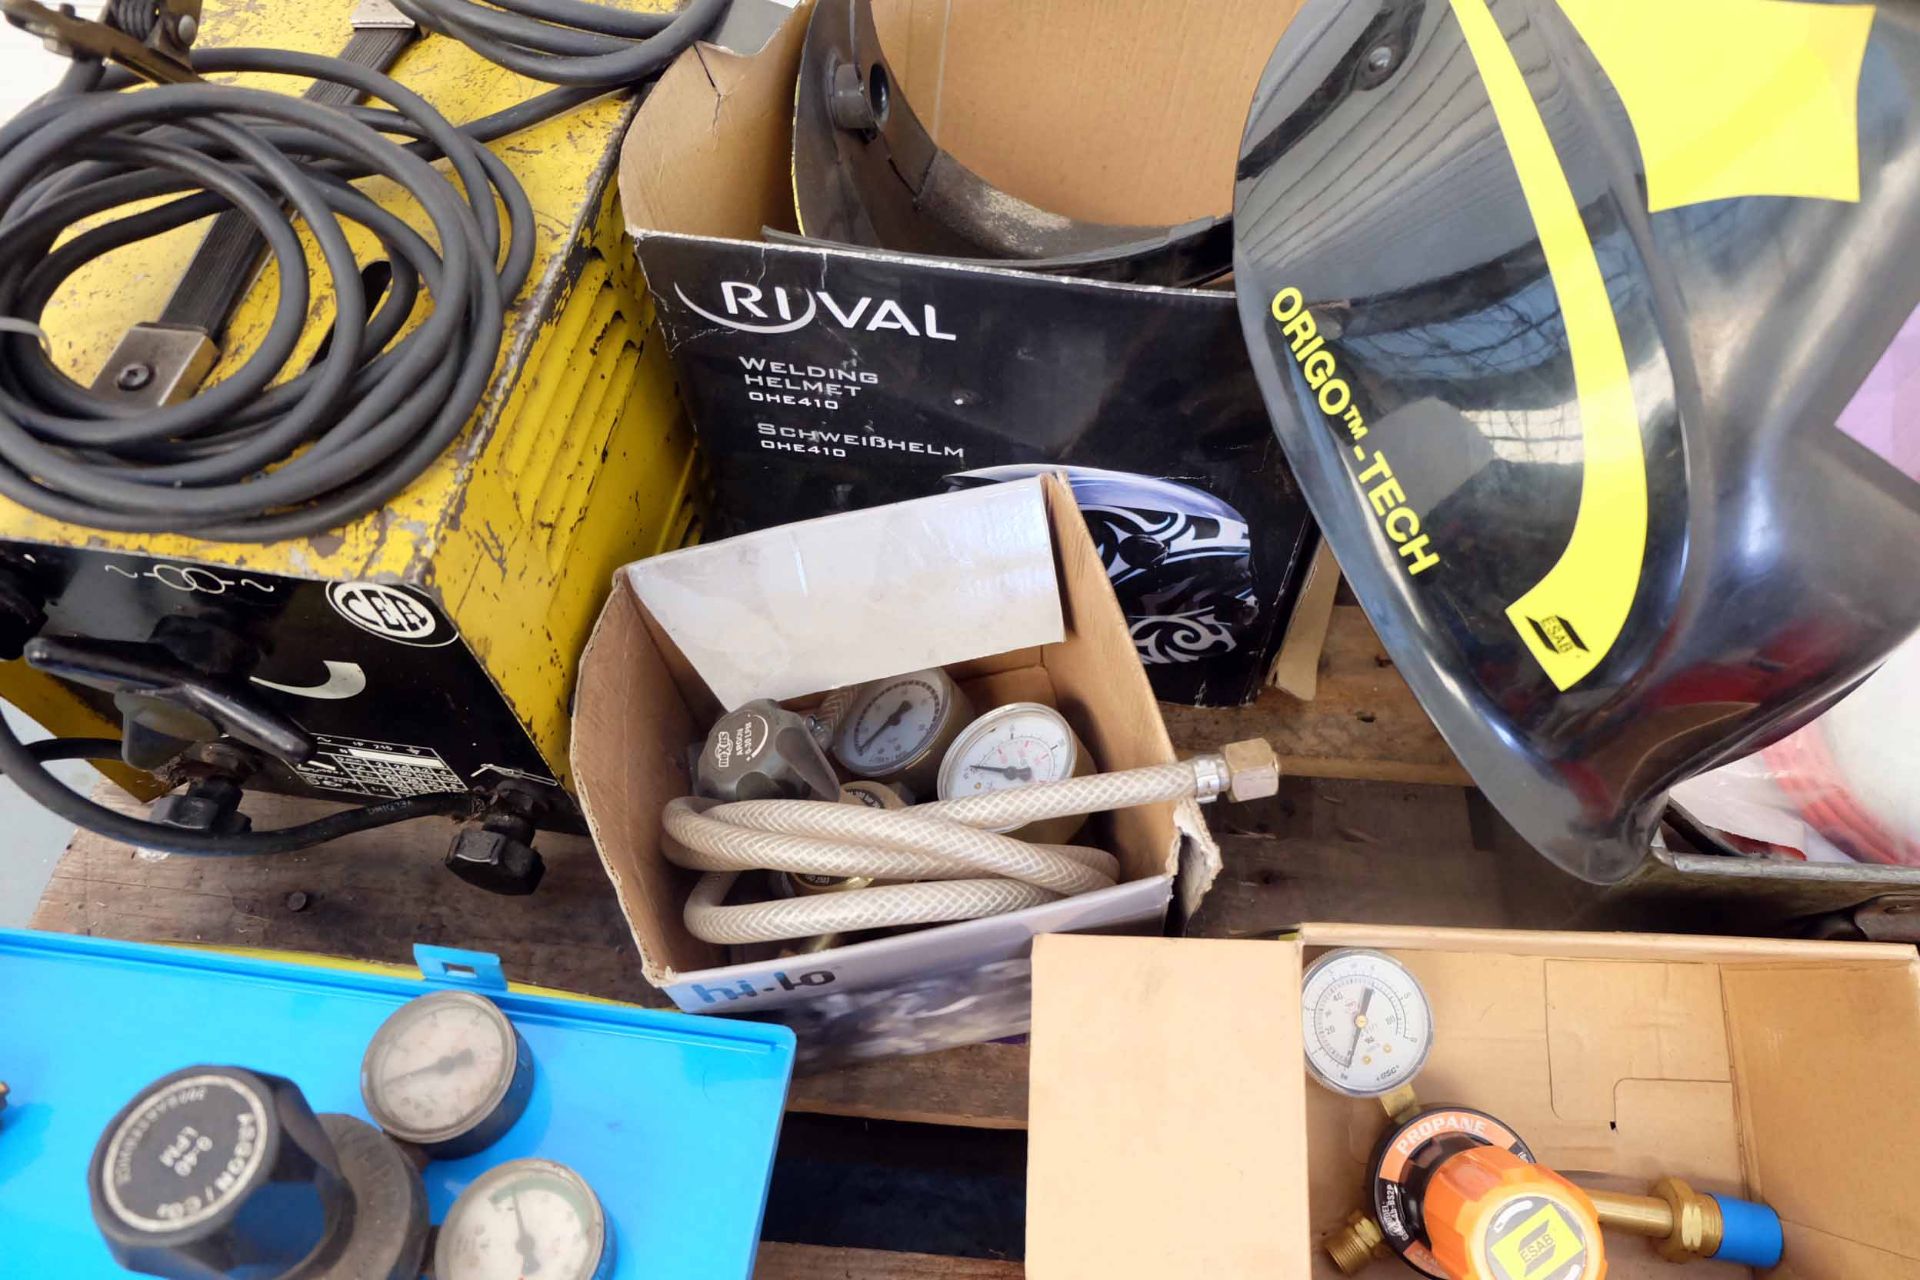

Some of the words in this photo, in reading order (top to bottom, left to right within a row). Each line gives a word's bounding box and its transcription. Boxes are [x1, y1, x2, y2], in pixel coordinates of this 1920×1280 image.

[720, 281, 957, 341] RIVAL
[739, 356, 879, 384] WELDING
[744, 374, 862, 397] HELMET
[736, 728, 744, 756] ARGON
[1396, 1116, 1487, 1156] PROPANE
[1519, 1233, 1555, 1263] ESAB
